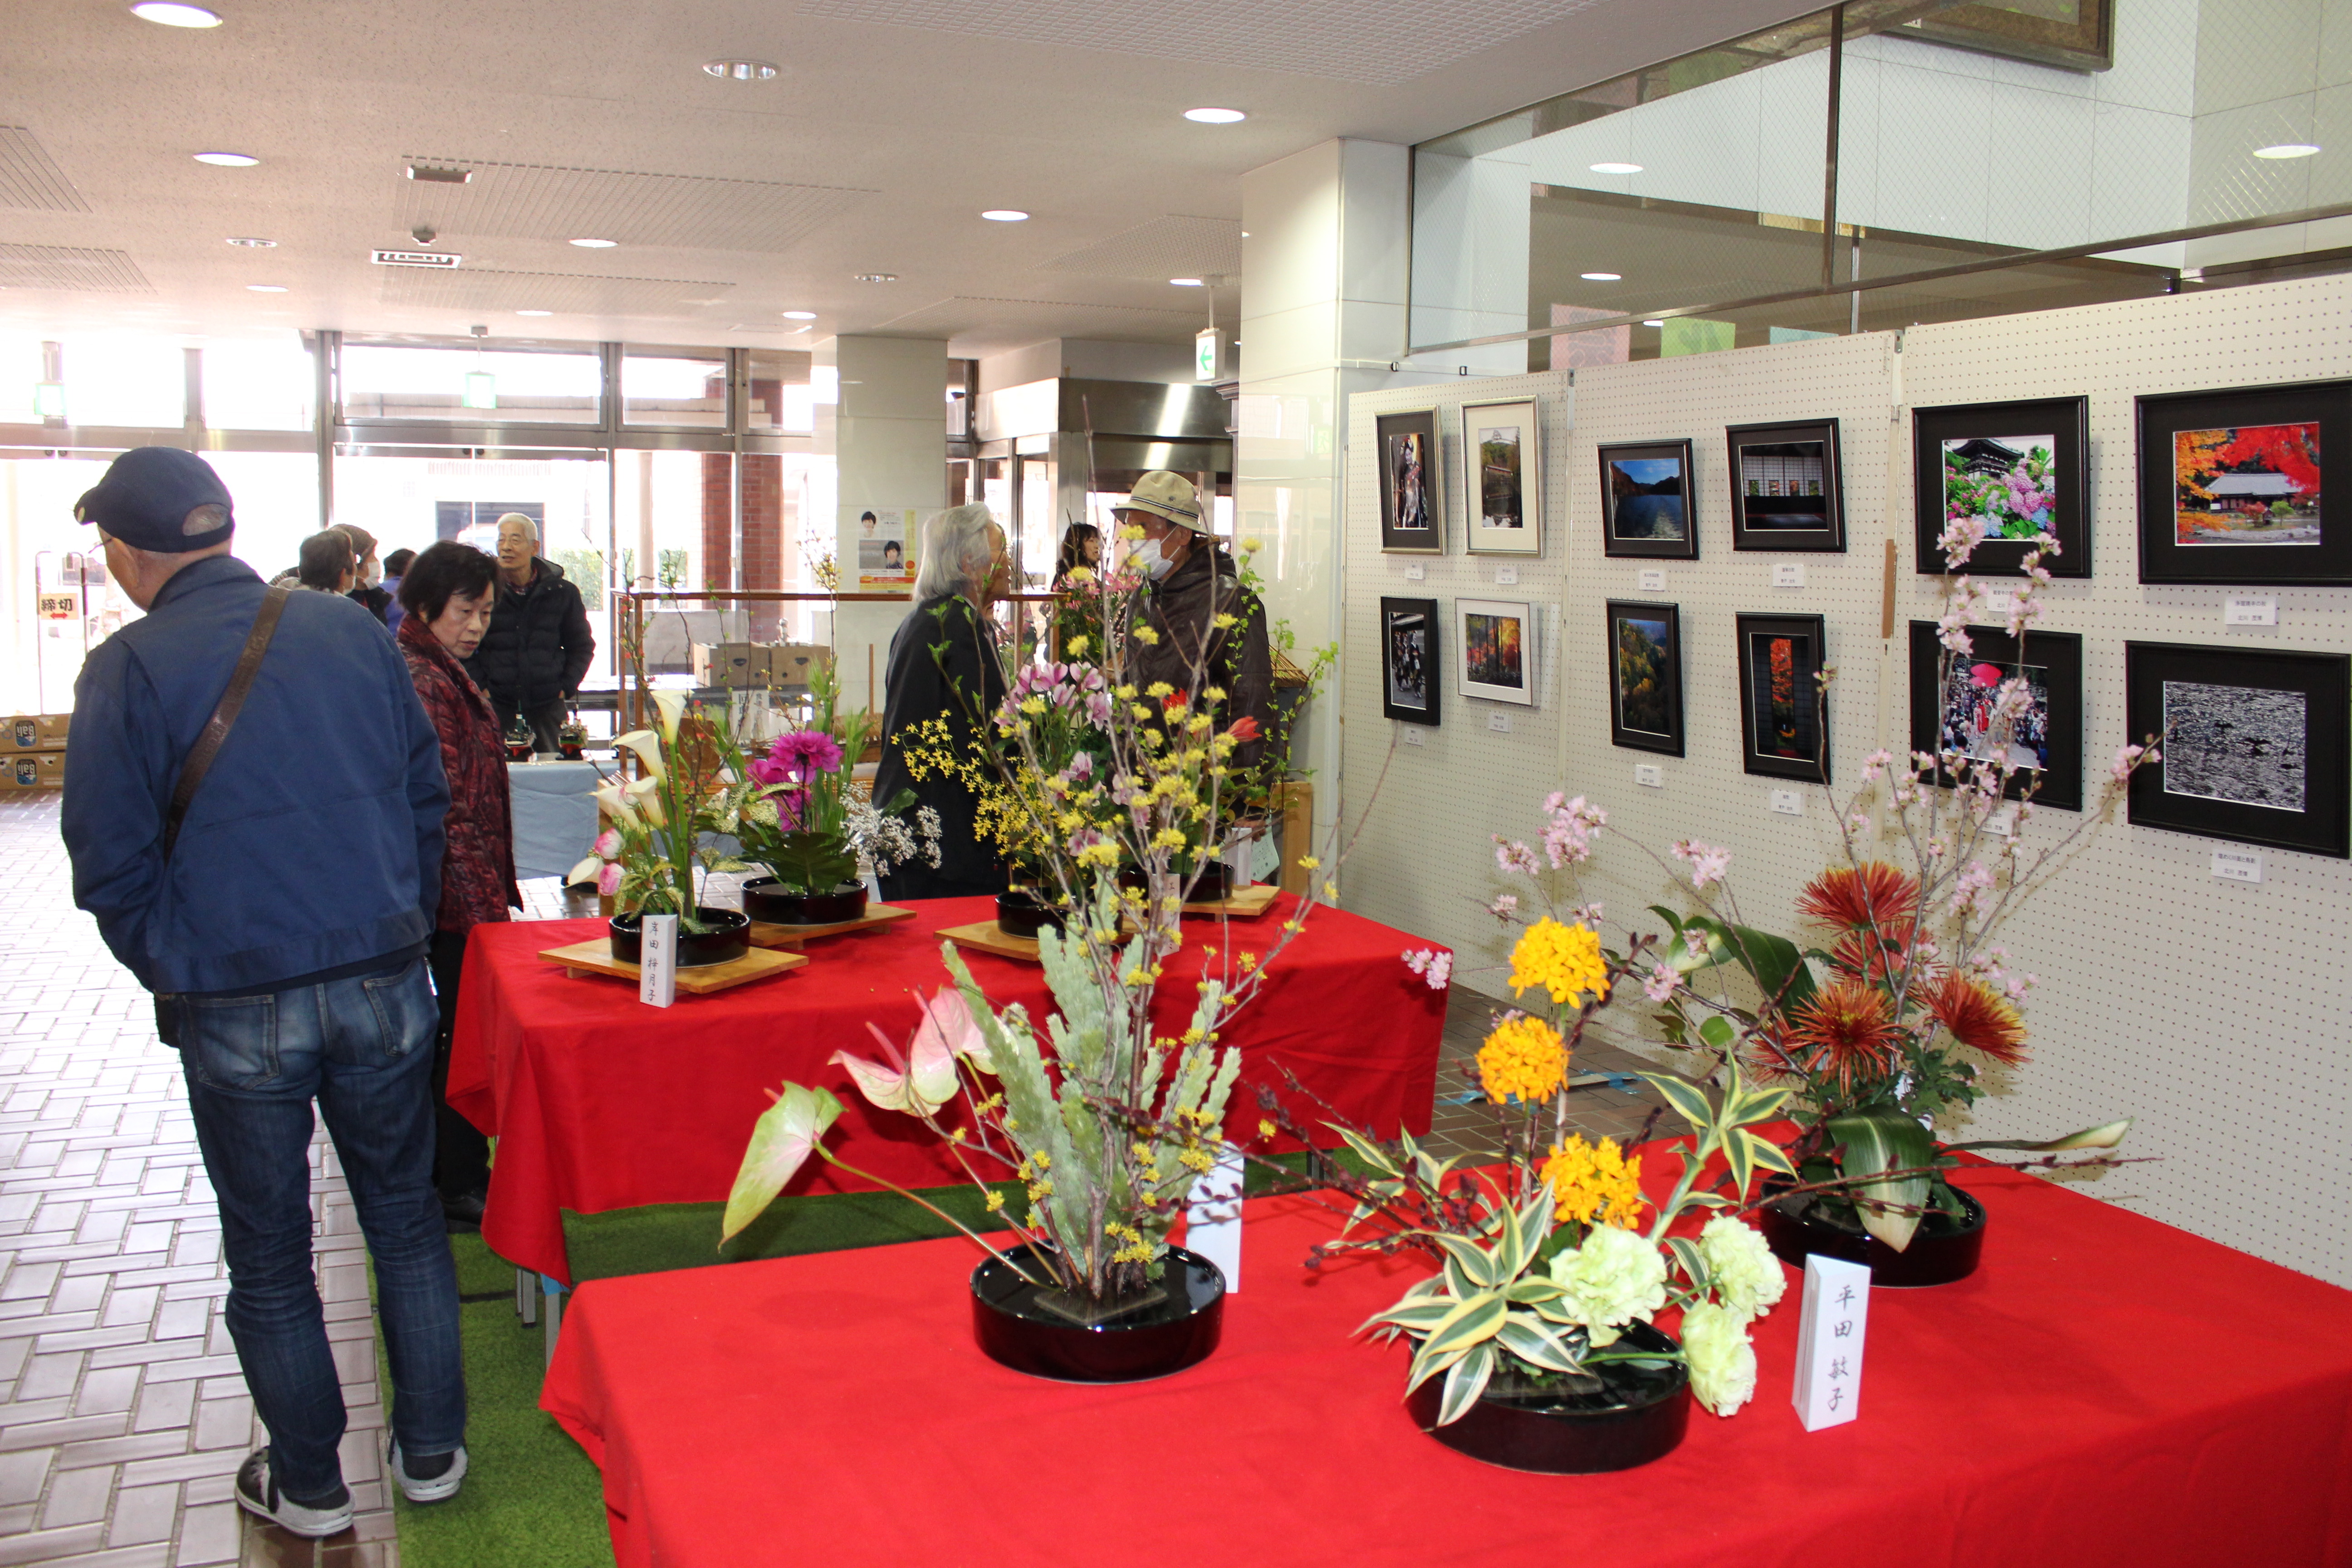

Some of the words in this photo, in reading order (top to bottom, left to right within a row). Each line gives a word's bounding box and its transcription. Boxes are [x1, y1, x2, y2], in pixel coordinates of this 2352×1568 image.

[41, 598, 73, 612] 締切
[16, 725, 35, 737] Bali
[17, 764, 35, 775] Bali
